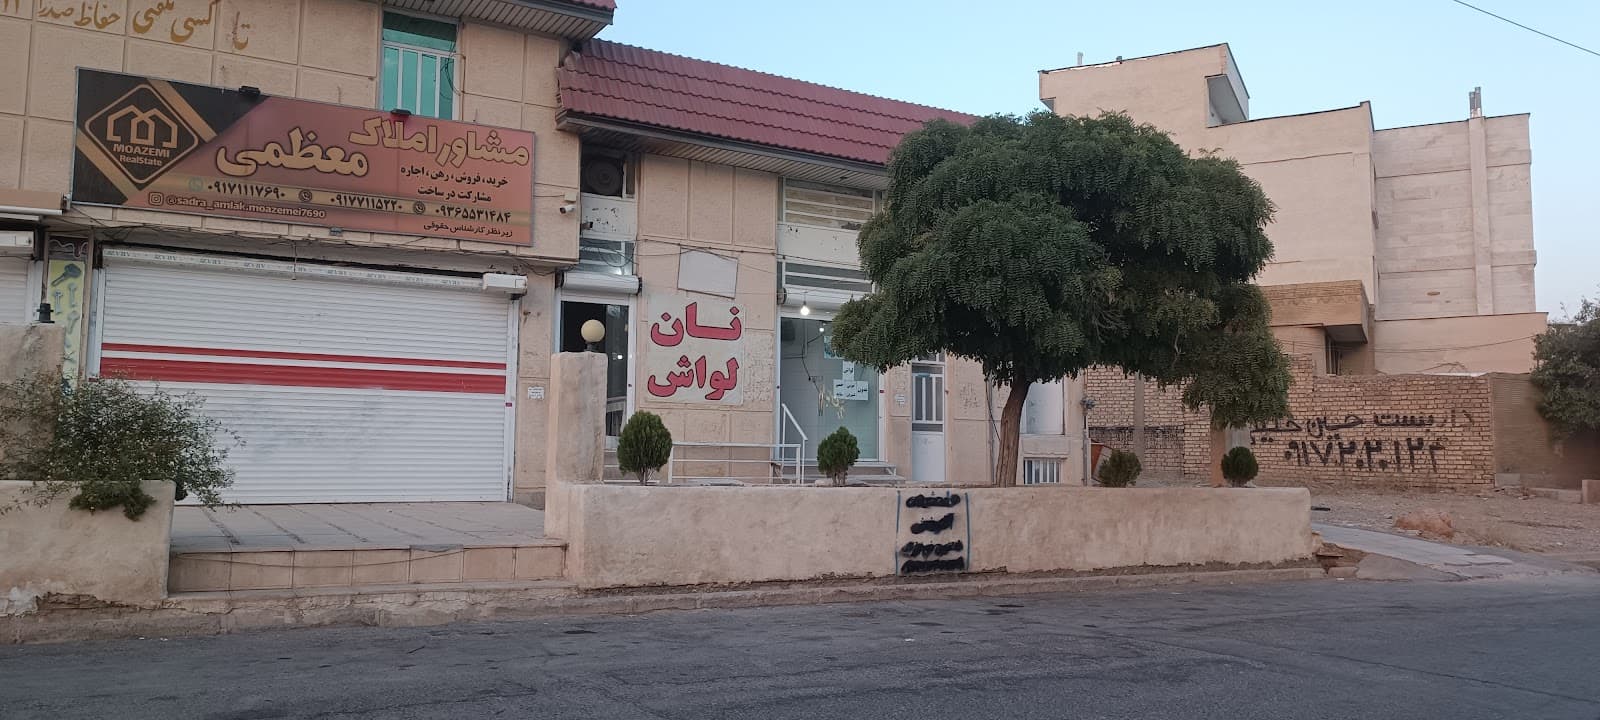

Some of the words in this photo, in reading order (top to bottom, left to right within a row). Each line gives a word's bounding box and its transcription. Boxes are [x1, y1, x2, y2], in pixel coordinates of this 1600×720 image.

[348, 116, 437, 154] املاک
[113, 143, 170, 158] MOAZEMI
[216, 127, 369, 177] معظمی
[436, 130, 530, 168] مشاور
[400, 165, 425, 178] اجاره
[207, 181, 286, 200] ۰۹۱۷۱۱۱۷۶۹۰
[417, 186, 445, 197] ساخت
[446, 189, 456, 200] در
[458, 190, 492, 203] مشارکت
[650, 301, 742, 347] نان
[647, 355, 740, 401] لواش
